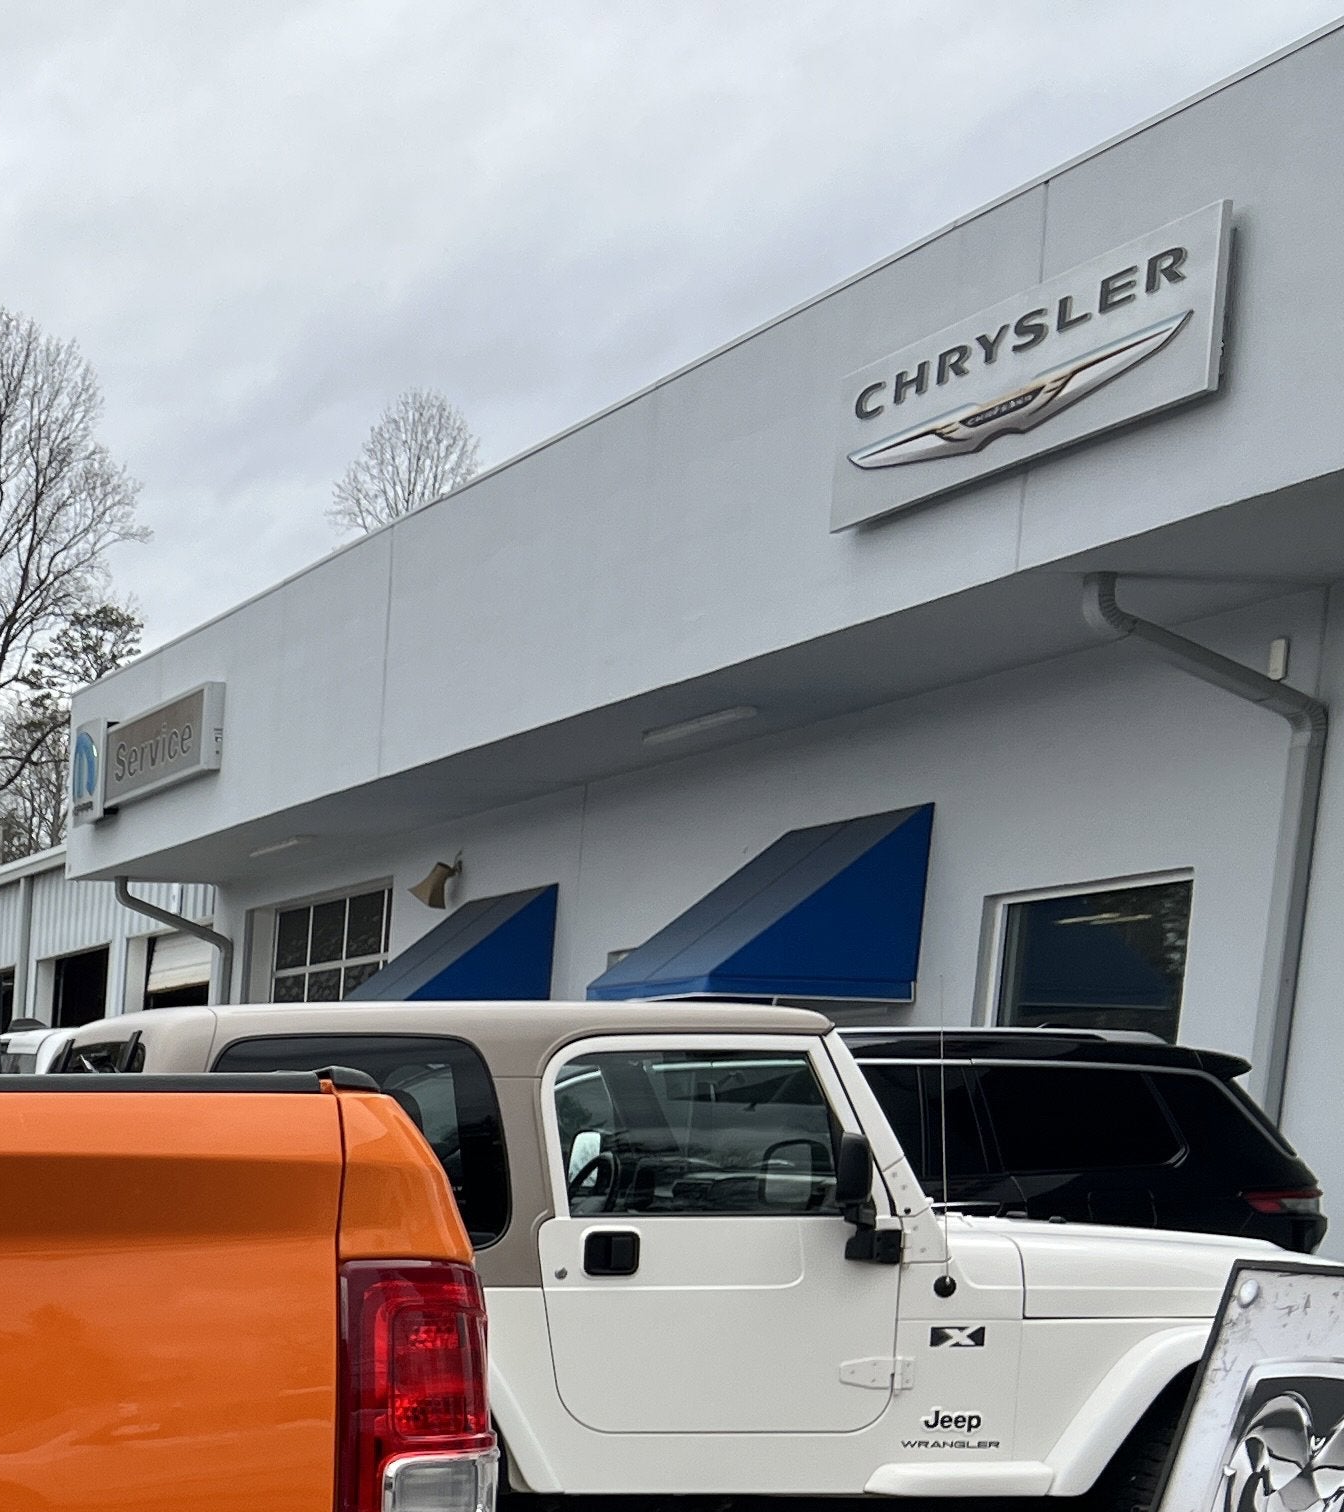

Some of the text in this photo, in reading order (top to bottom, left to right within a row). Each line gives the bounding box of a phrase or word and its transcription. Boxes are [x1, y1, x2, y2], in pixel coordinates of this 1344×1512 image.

[855, 246, 1188, 420] CHRYSLER
[114, 723, 192, 782] Service
[923, 1410, 982, 1433] Jeep
[900, 1440, 1000, 1449] WRANGLER
